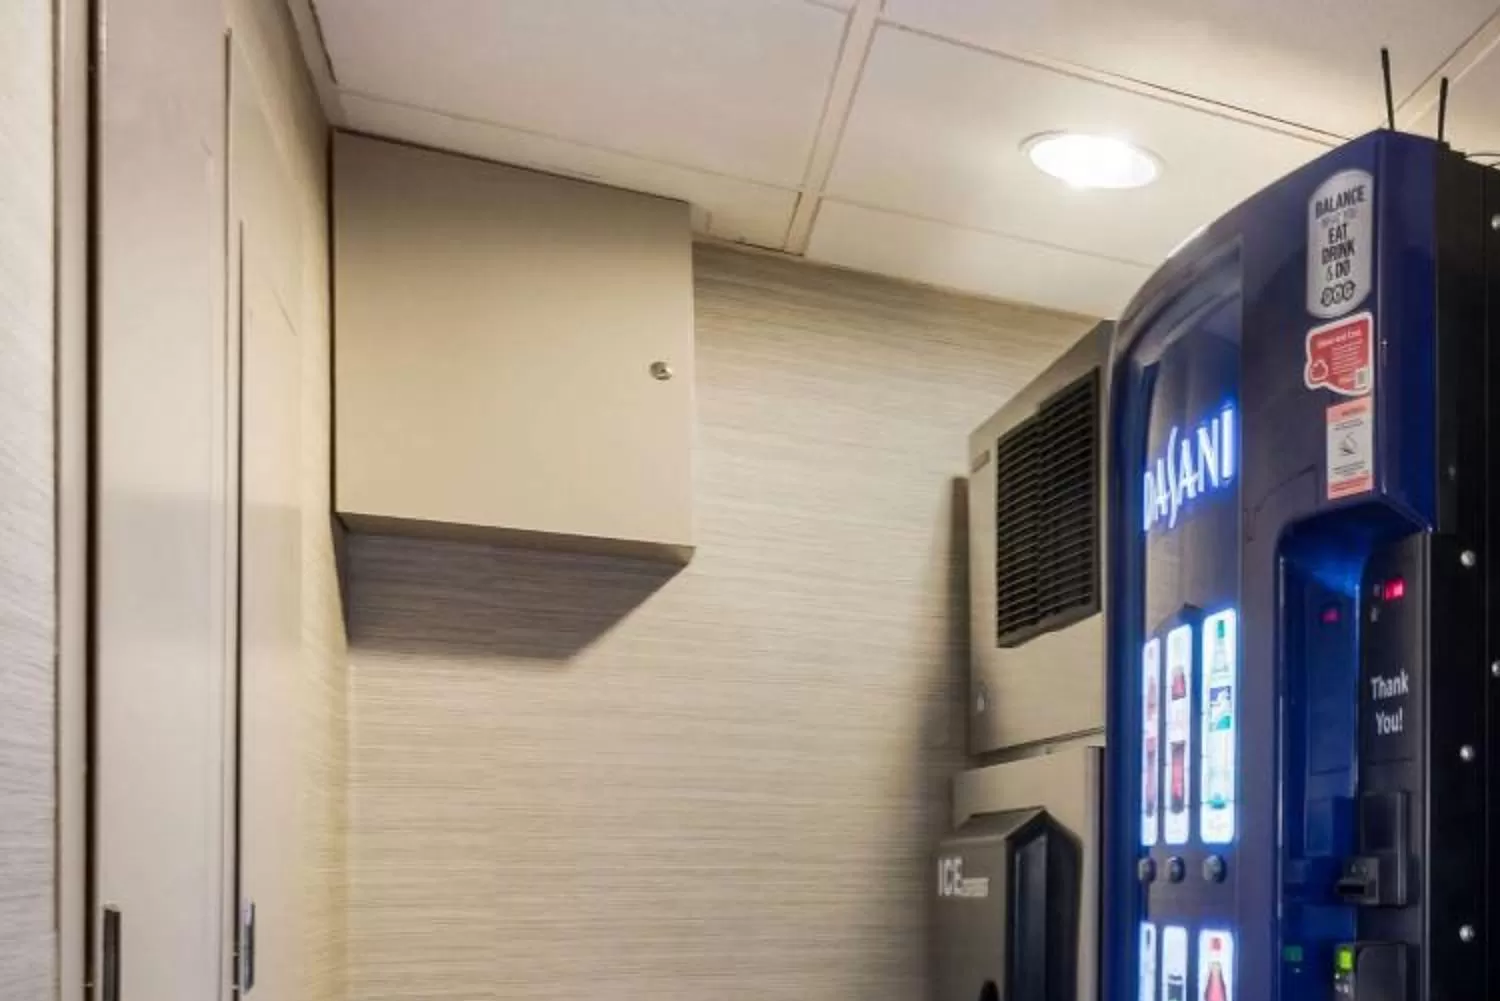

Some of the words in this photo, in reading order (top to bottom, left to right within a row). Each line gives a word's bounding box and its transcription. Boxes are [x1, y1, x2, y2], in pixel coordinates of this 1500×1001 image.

[1315, 185, 1367, 219] BALANCE
[1328, 223, 1348, 244] EAT
[1322, 239, 1355, 265] DRINK
[1144, 408, 1233, 530] DASANI
[1370, 669, 1409, 700] Thank
[1375, 708, 1404, 736] You!
